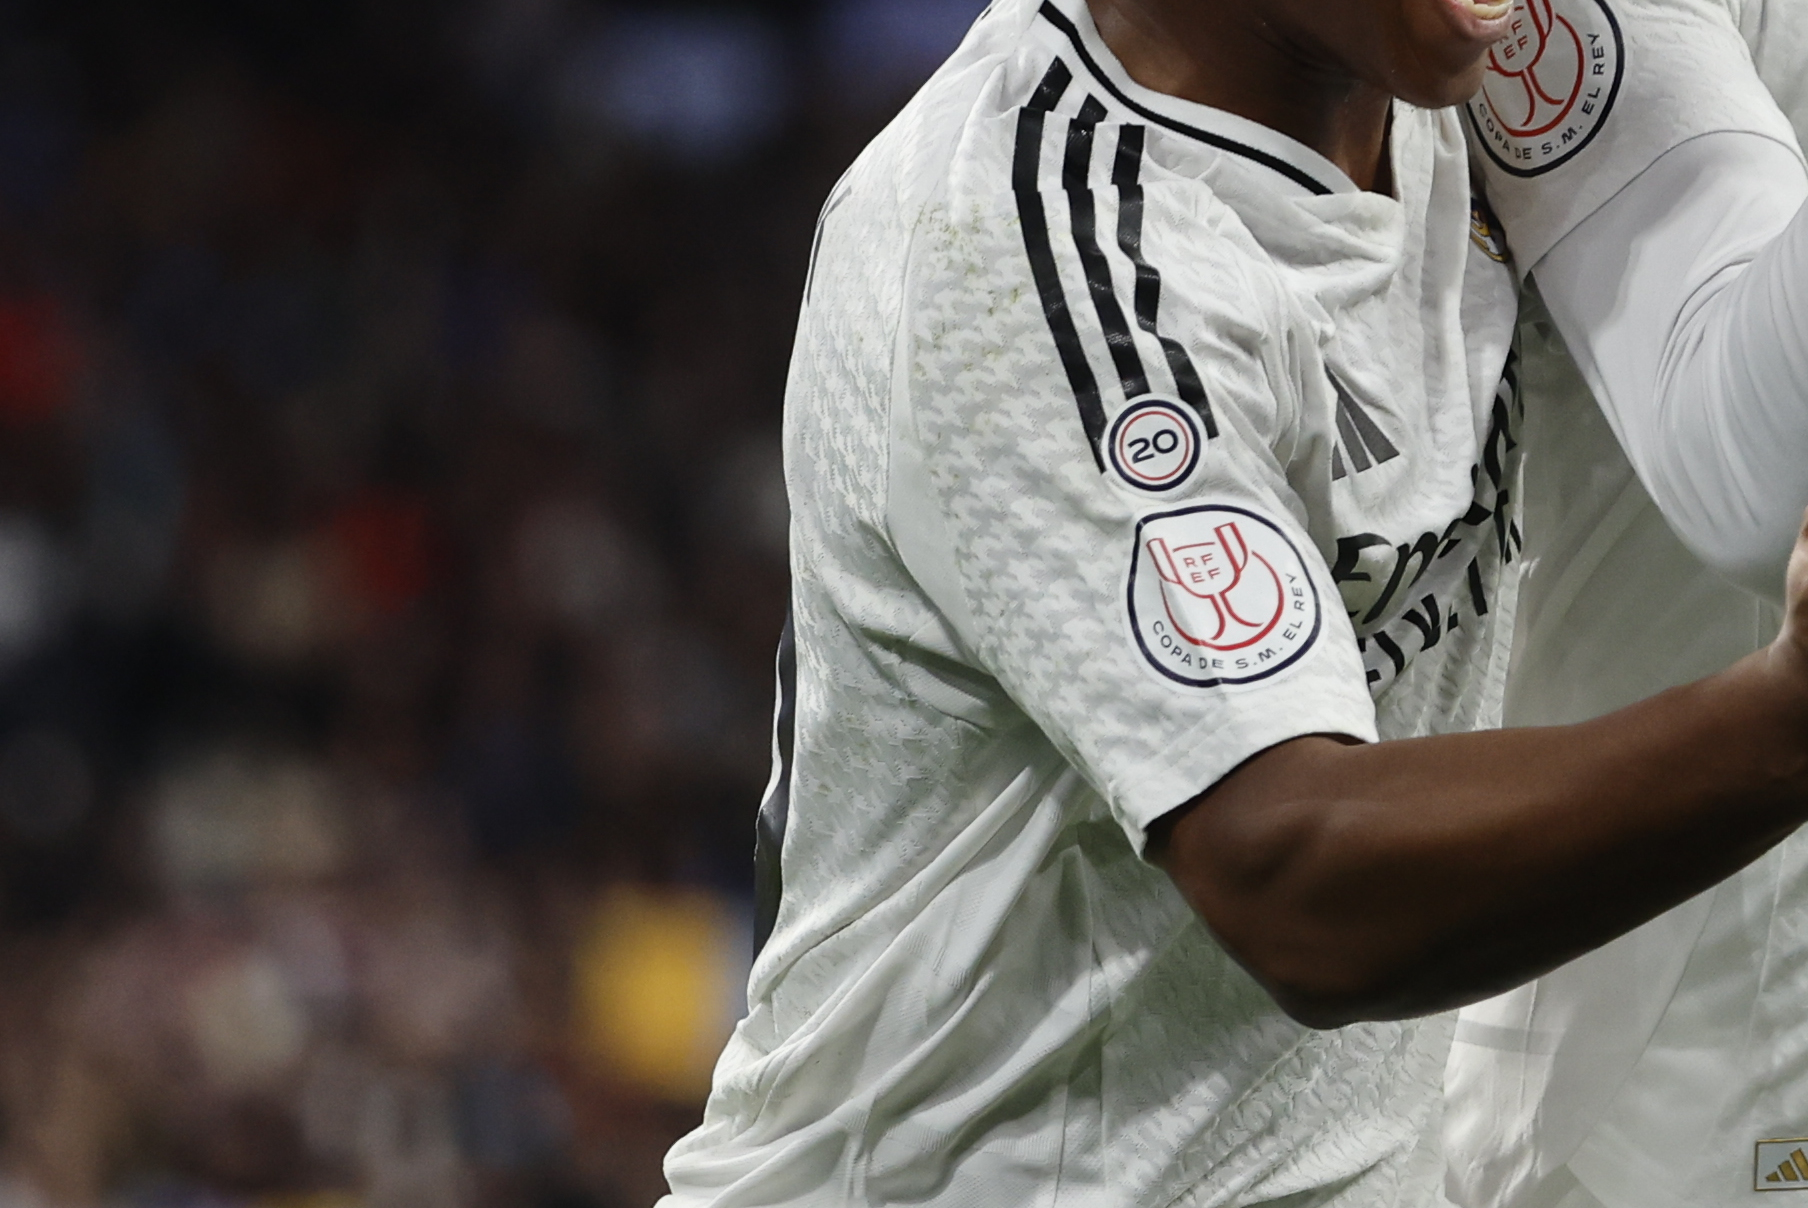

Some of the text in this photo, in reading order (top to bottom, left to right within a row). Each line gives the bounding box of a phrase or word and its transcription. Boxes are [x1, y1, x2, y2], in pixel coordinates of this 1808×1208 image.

[1479, 32, 1605, 160] COPA DE S.M. EL REY
[1127, 428, 1179, 464] 20
[1152, 572, 1306, 670] COPA DE S.M. EL REY
